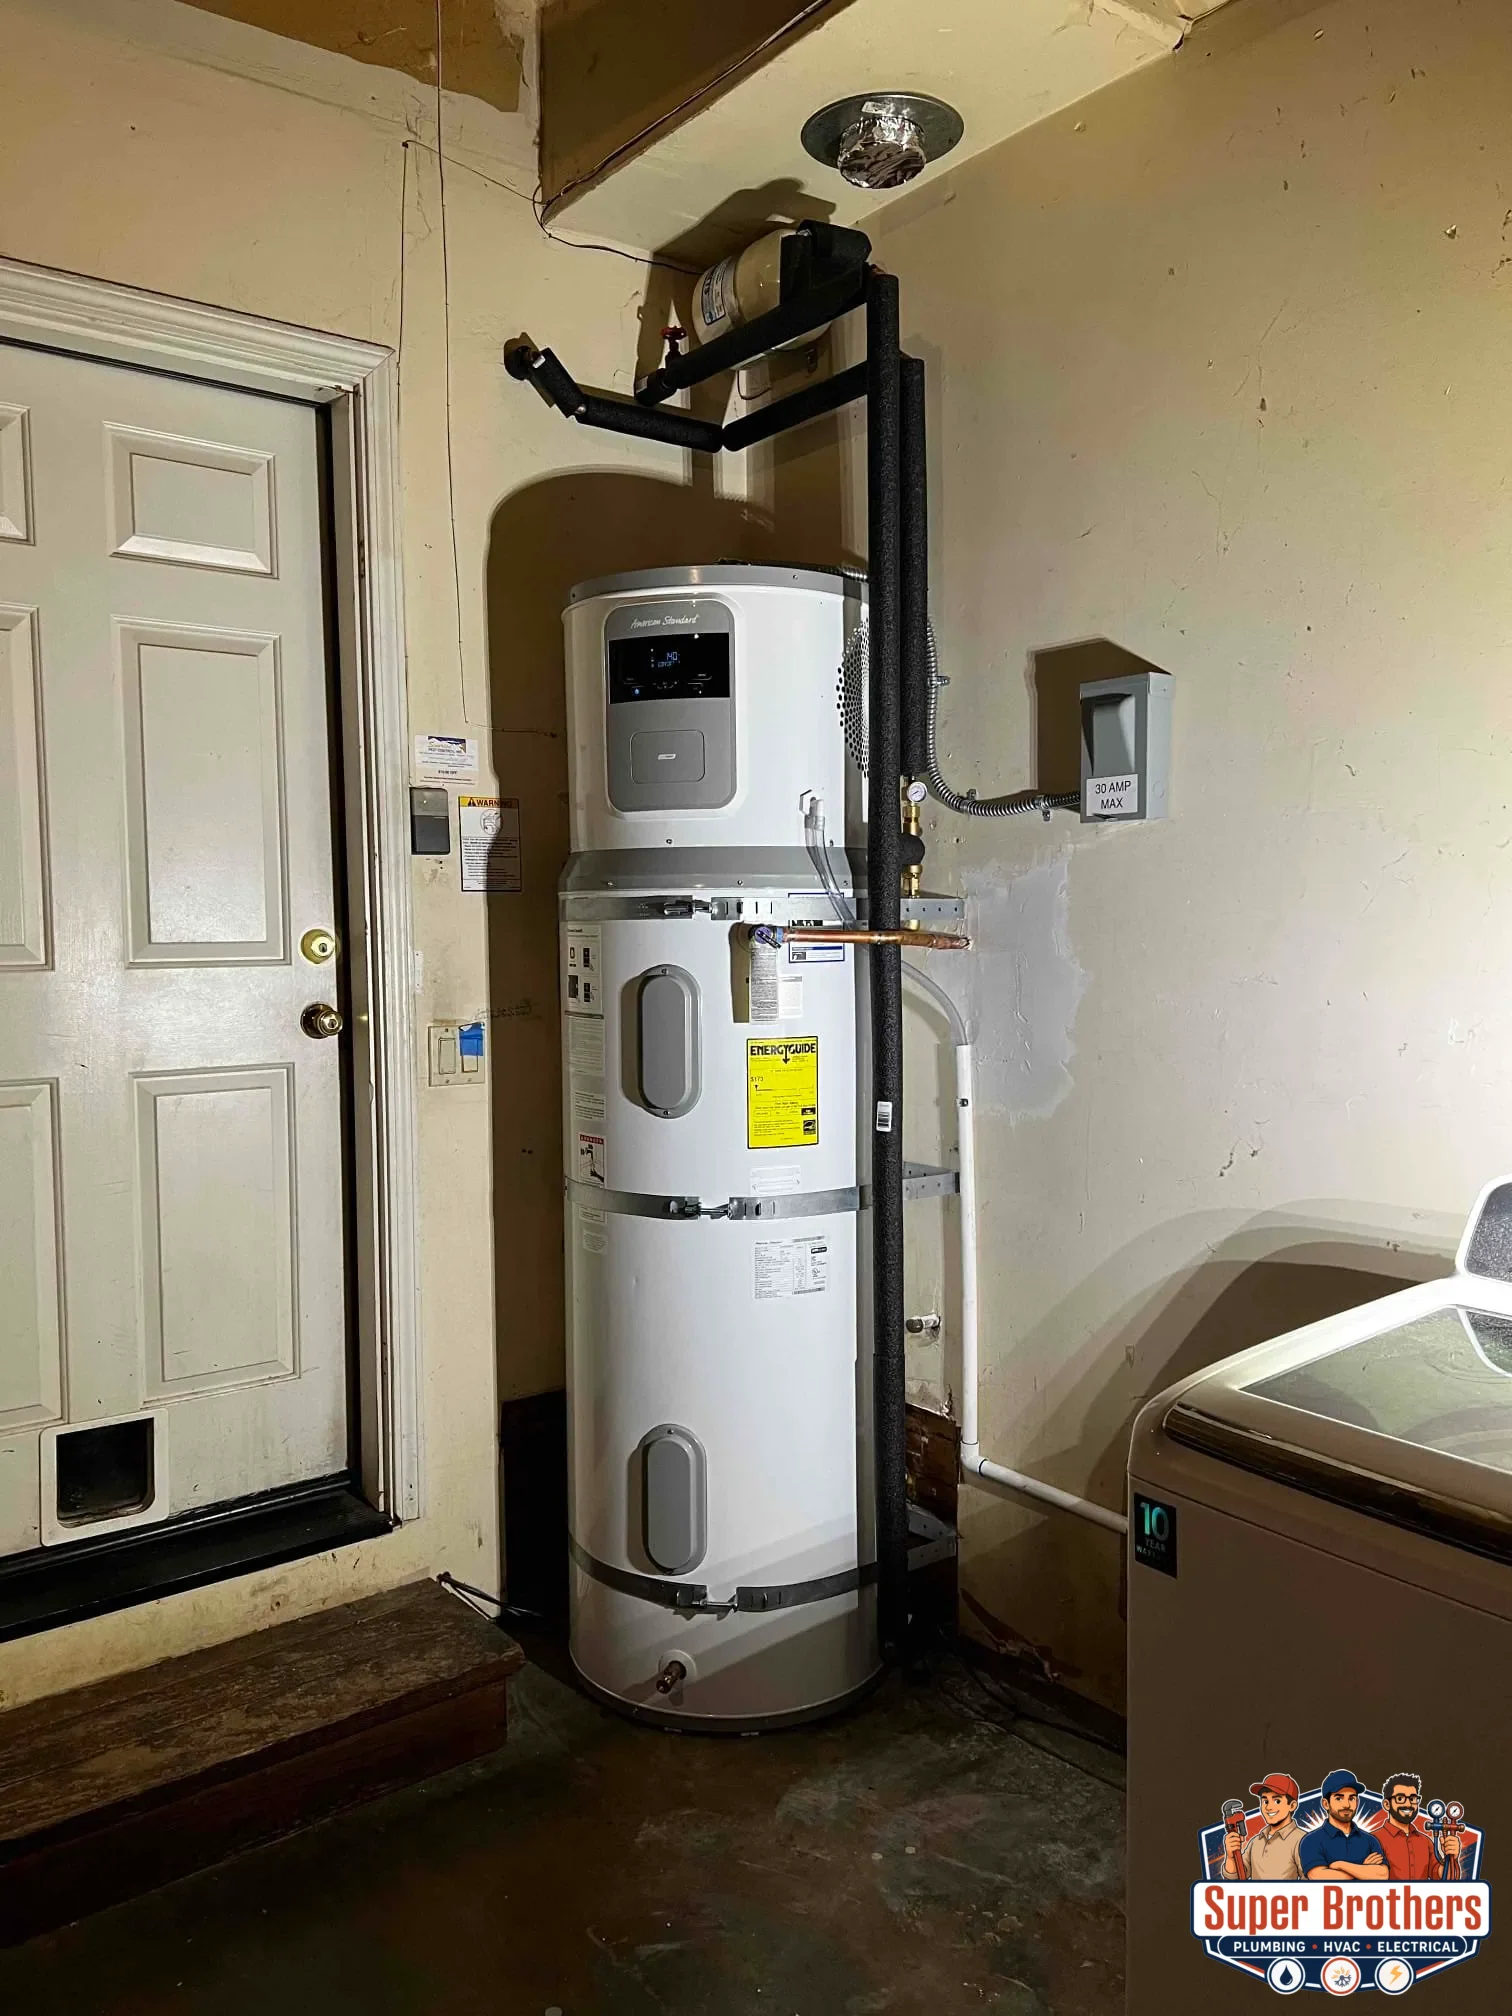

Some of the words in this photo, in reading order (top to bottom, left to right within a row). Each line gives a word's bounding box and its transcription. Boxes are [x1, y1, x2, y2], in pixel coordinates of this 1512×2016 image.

[630, 617, 661, 629] American
[662, 614, 699, 627] Standard
[1095, 783, 1107, 794] 30
[1108, 780, 1132, 793] AMP
[476, 799, 512, 808] WARNING
[1100, 797, 1124, 809] MAX
[1140, 1502, 1169, 1541] 10
